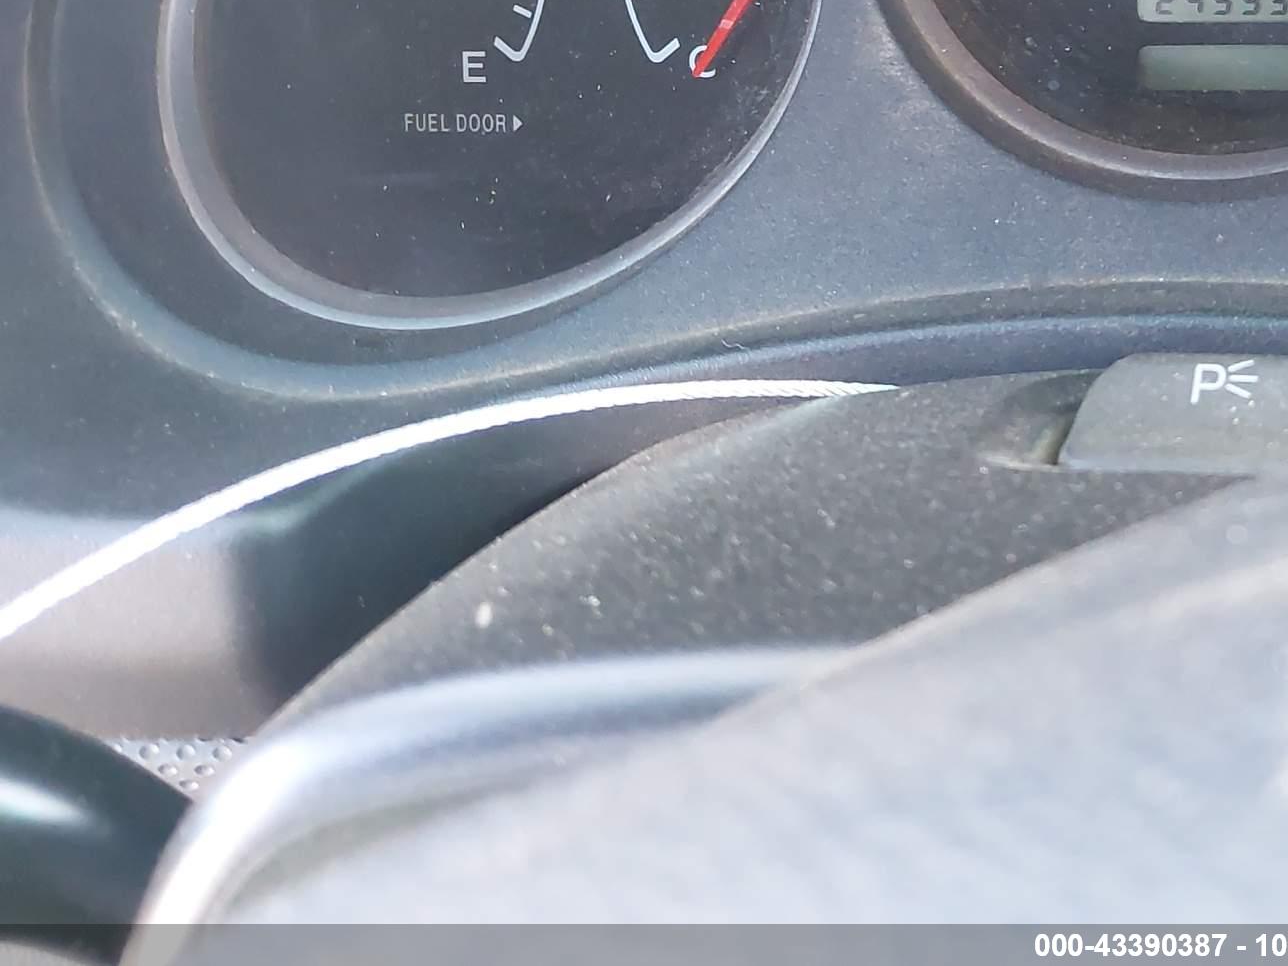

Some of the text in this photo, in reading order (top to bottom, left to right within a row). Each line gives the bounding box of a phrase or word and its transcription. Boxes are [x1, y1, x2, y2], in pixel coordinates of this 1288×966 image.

[461, 51, 487, 84] E
[404, 113, 507, 134] FUEL DOOR
